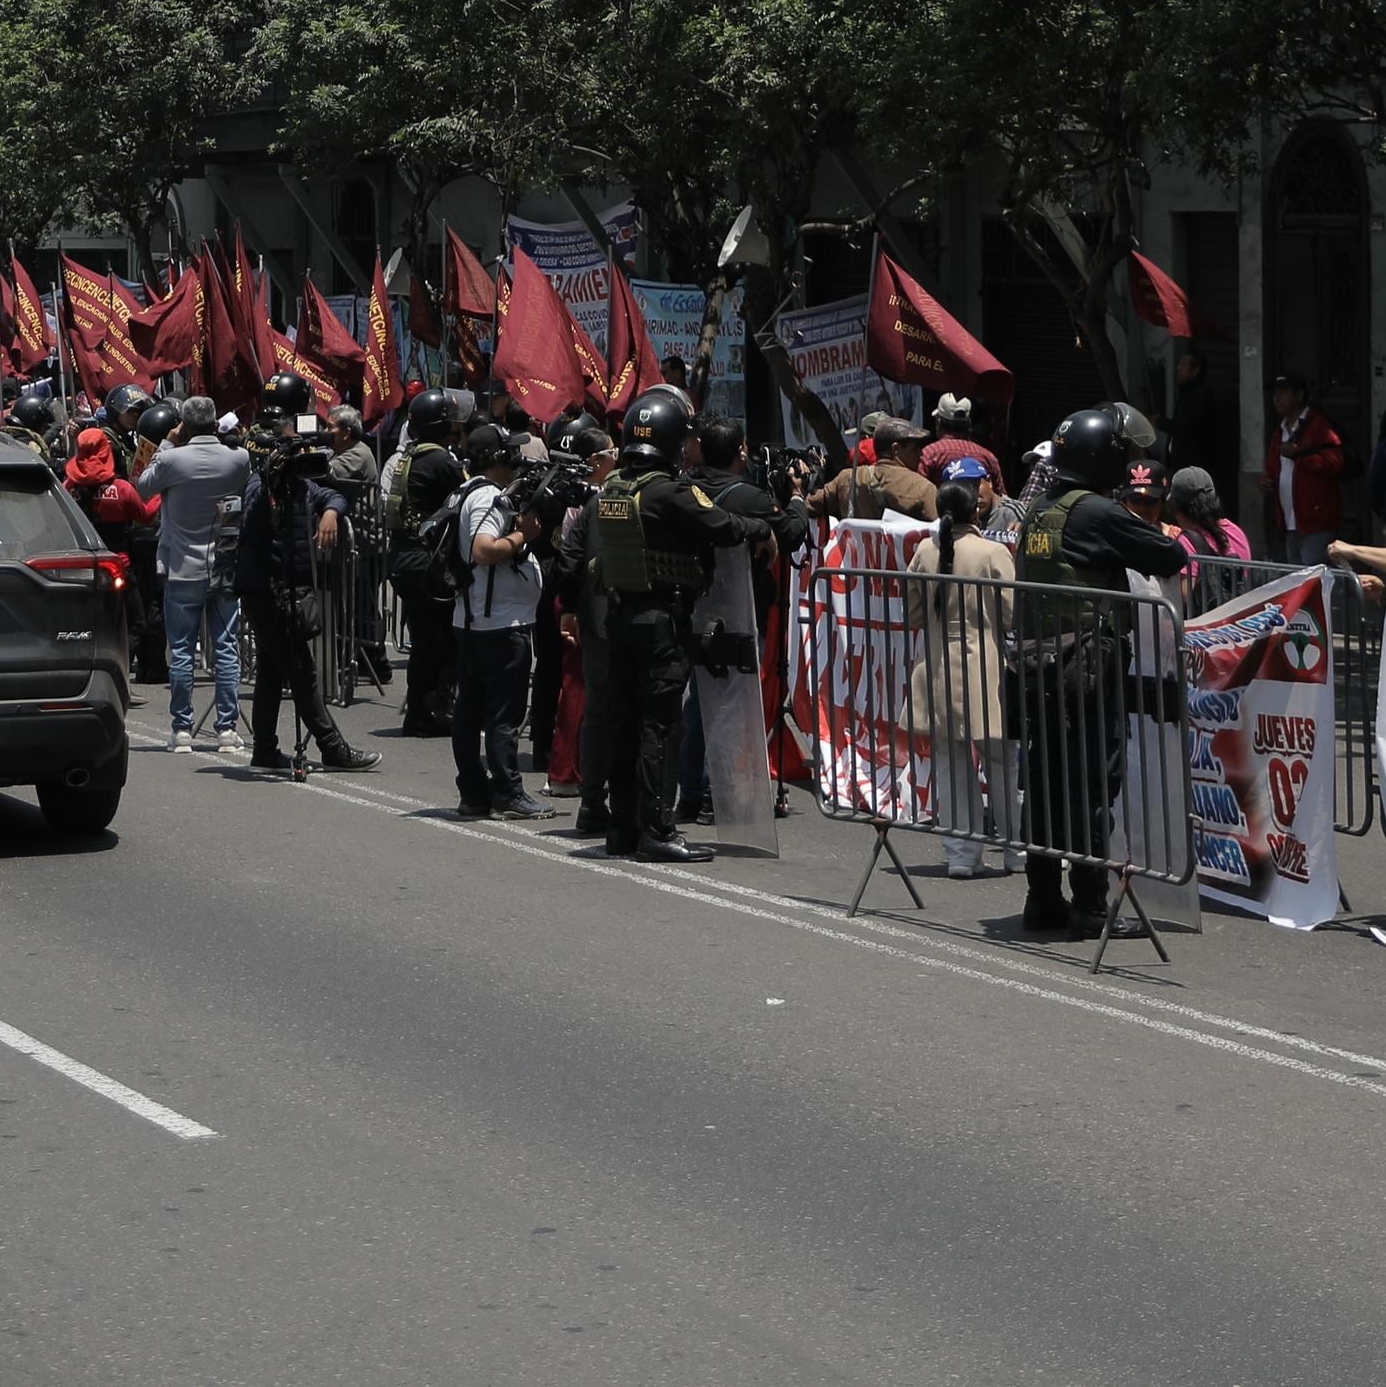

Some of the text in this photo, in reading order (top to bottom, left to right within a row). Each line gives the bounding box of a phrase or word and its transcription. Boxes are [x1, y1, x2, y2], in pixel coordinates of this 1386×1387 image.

[791, 339, 865, 382] OMBRAM
[906, 350, 931, 368] PARA
[634, 425, 653, 438] USE
[1130, 477, 1152, 486] adidas
[1254, 714, 1315, 755] JUEVES
